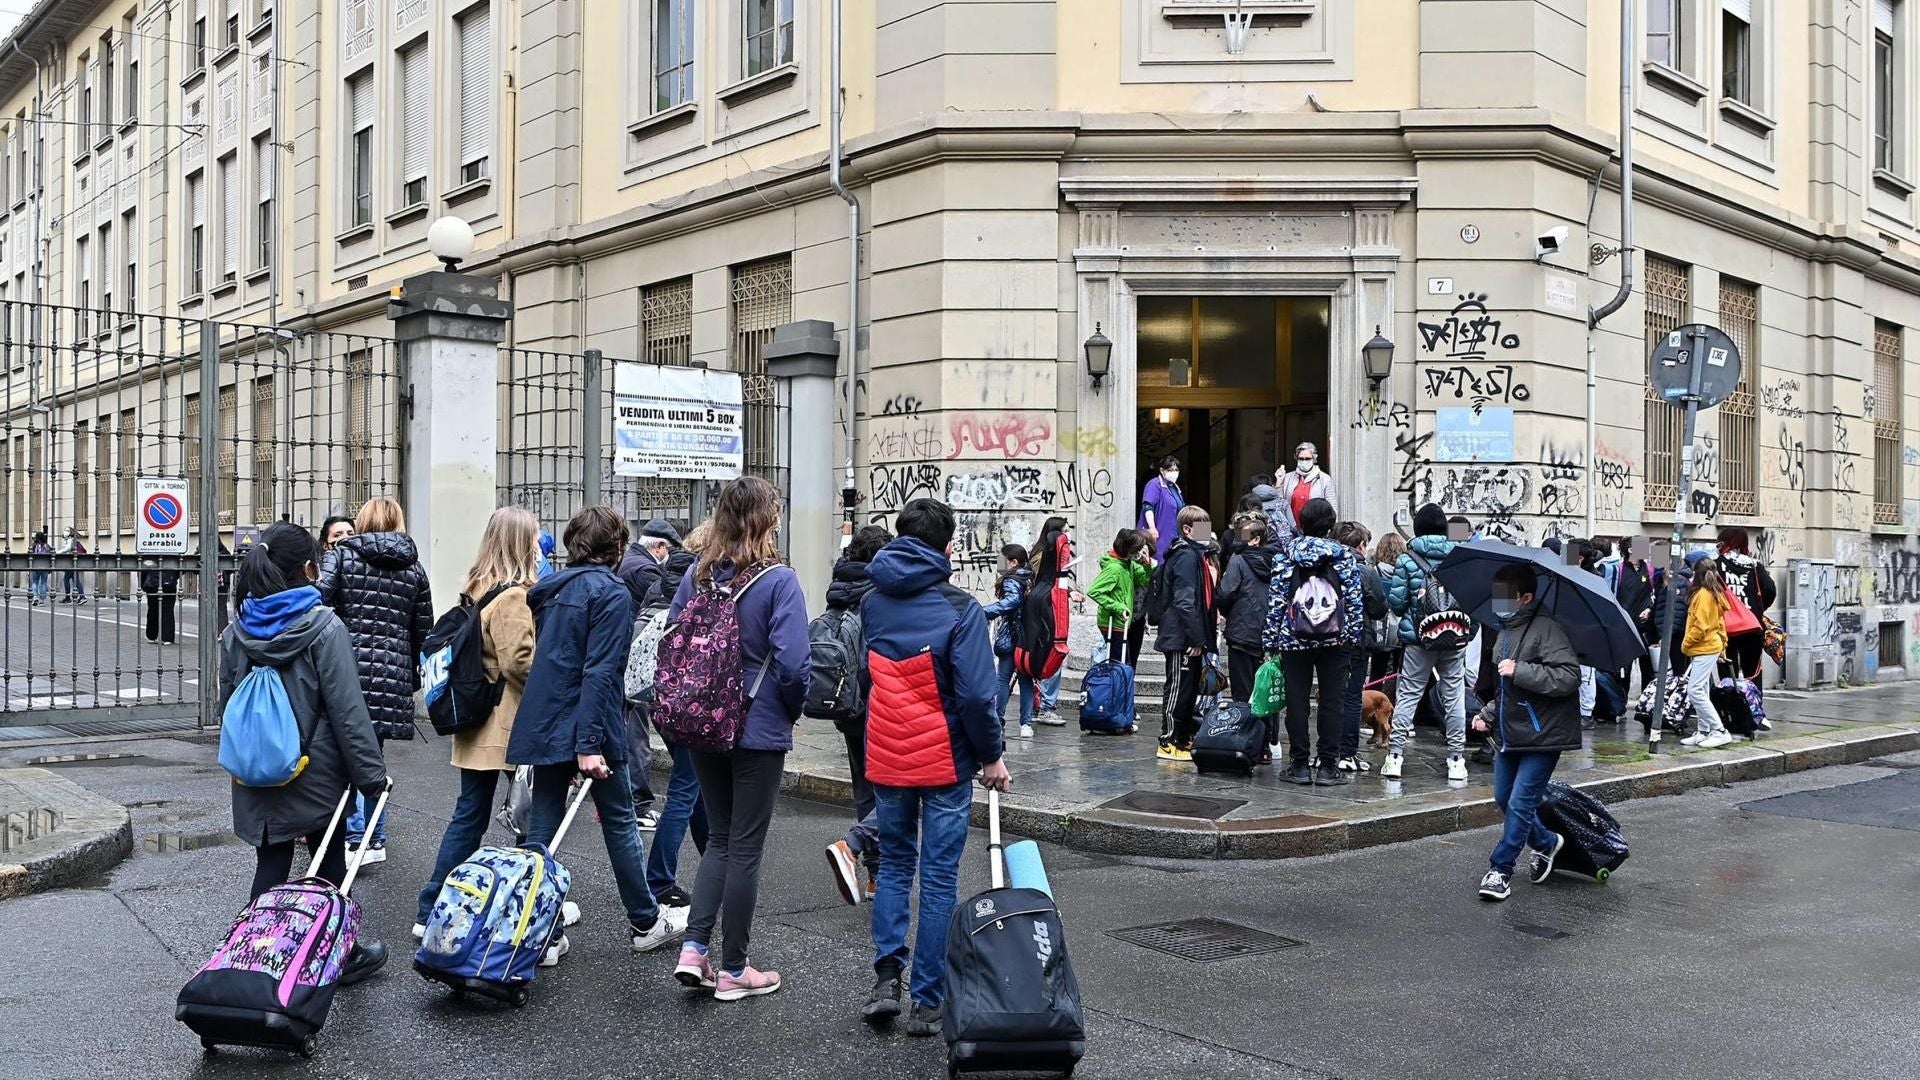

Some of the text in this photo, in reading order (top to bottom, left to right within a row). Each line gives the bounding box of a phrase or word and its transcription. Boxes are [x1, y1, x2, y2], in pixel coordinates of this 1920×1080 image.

[1436, 281, 1445, 291] 7
[619, 406, 735, 425] VENDITA ULTIMI 5 BOX
[1725, 571, 1748, 586] ME
